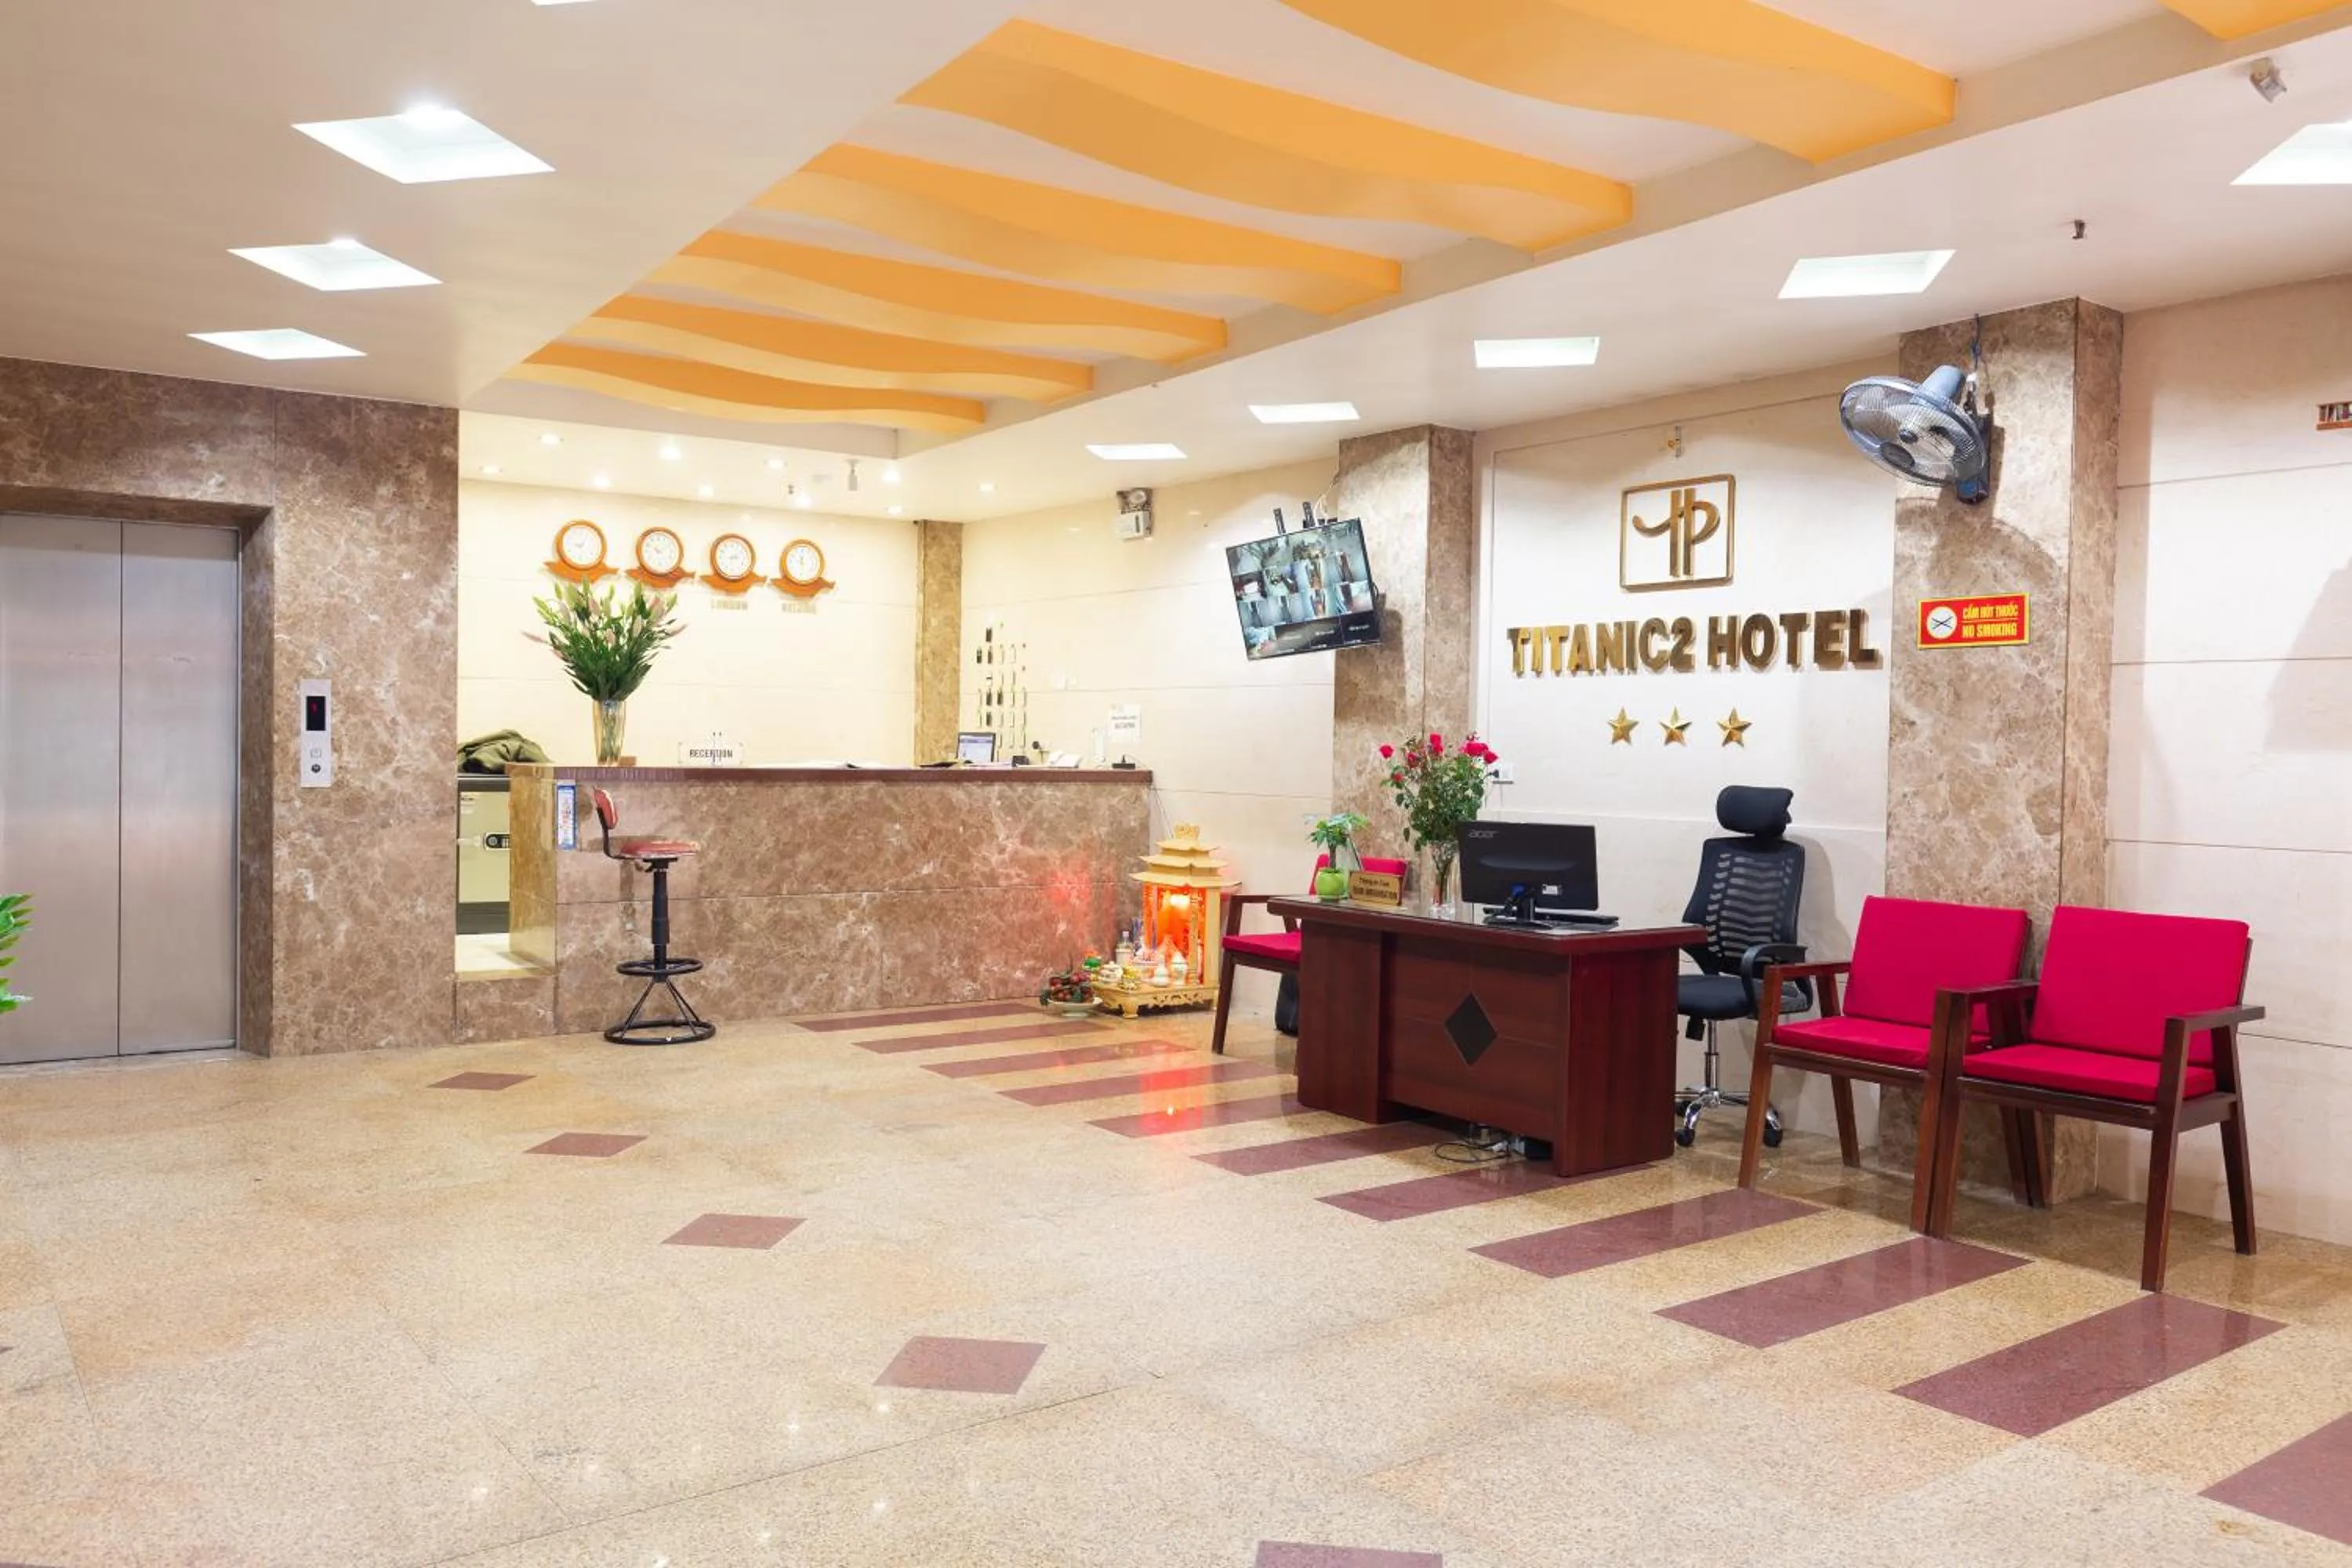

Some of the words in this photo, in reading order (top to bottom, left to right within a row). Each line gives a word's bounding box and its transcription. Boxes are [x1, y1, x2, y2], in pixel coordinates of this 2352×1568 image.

[1962, 625, 1975, 638] NO
[1976, 622, 2017, 637] SMOKING
[1507, 616, 1697, 677] TITANIC2
[1707, 608, 1882, 671] HOTEL
[689, 749, 734, 758] RECEPTION
[1468, 829, 1499, 838] acer
